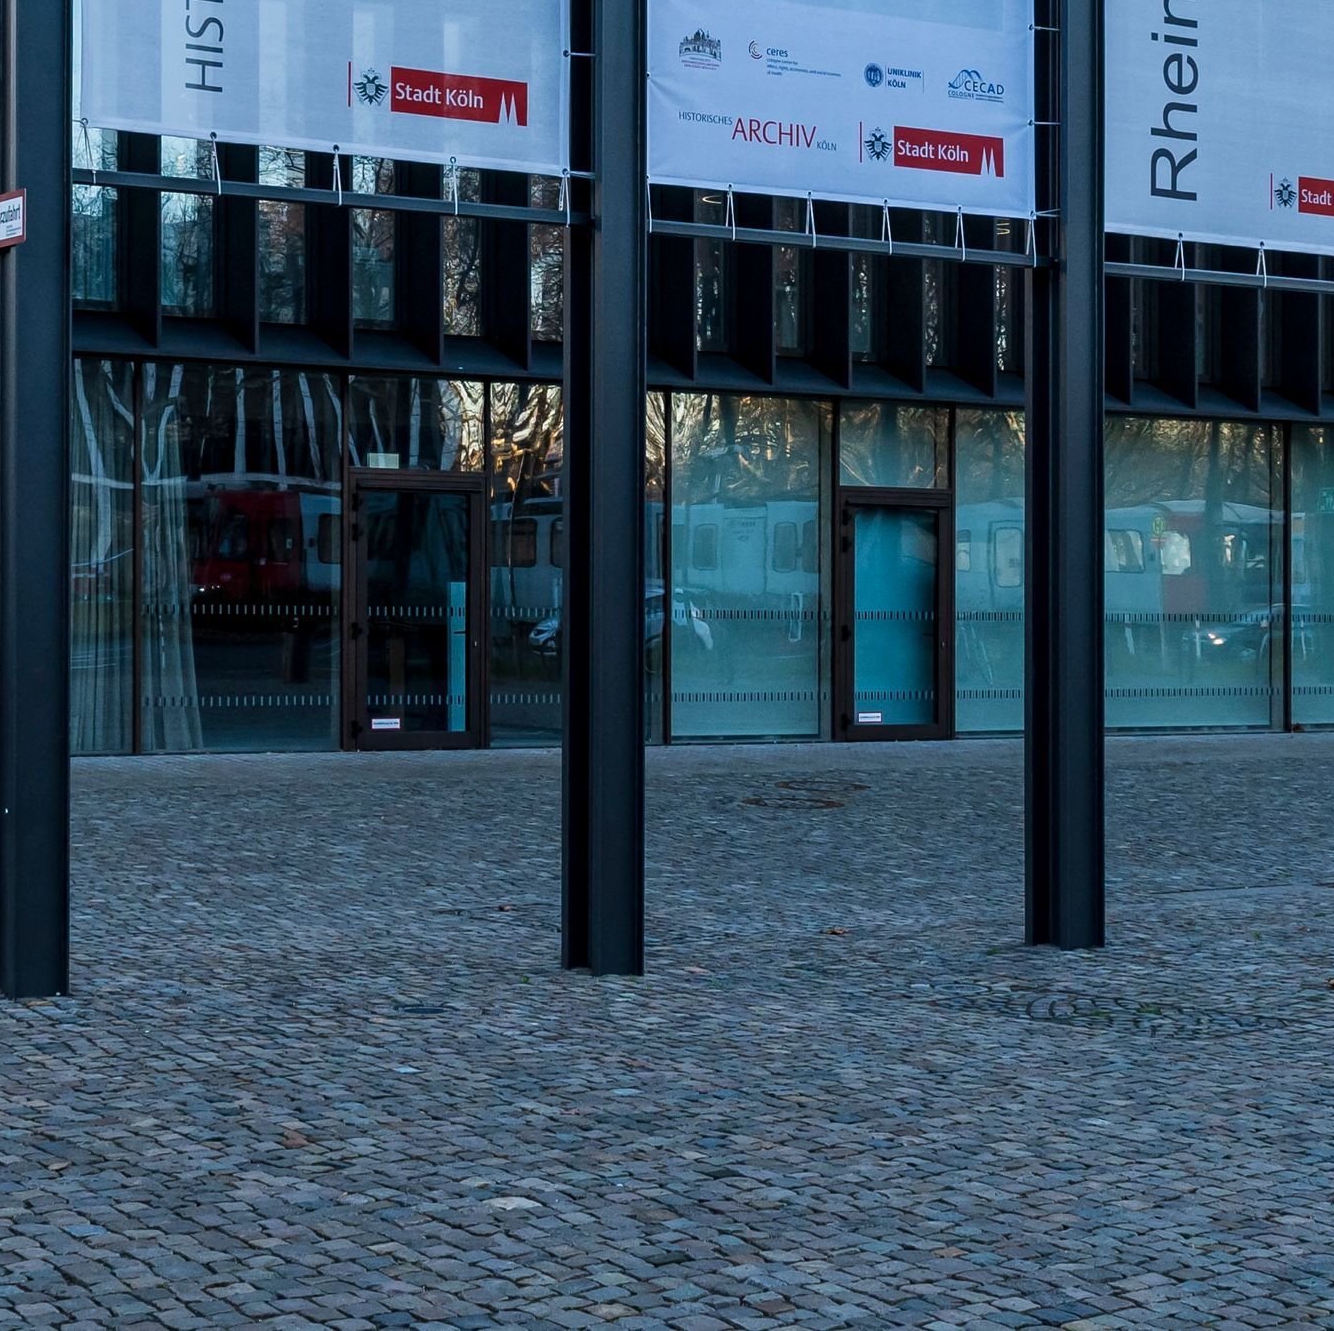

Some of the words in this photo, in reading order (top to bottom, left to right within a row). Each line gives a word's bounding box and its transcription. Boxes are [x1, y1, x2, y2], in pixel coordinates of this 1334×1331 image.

[766, 46, 789, 58] ceres
[887, 67, 922, 79] UNIKLINIK
[887, 79, 906, 89] KÖLN
[964, 79, 1005, 96] CECAD
[395, 81, 442, 105] Stadt
[445, 87, 485, 110] Köln
[947, 89, 975, 99] COLOGNE
[678, 110, 733, 126] HISTORISCHES
[732, 117, 817, 149] ARCHIV
[816, 140, 837, 151] KÖLN
[897, 139, 935, 159] Stadt
[938, 143, 969, 163] Köln
[1300, 188, 1332, 206] Stadt
